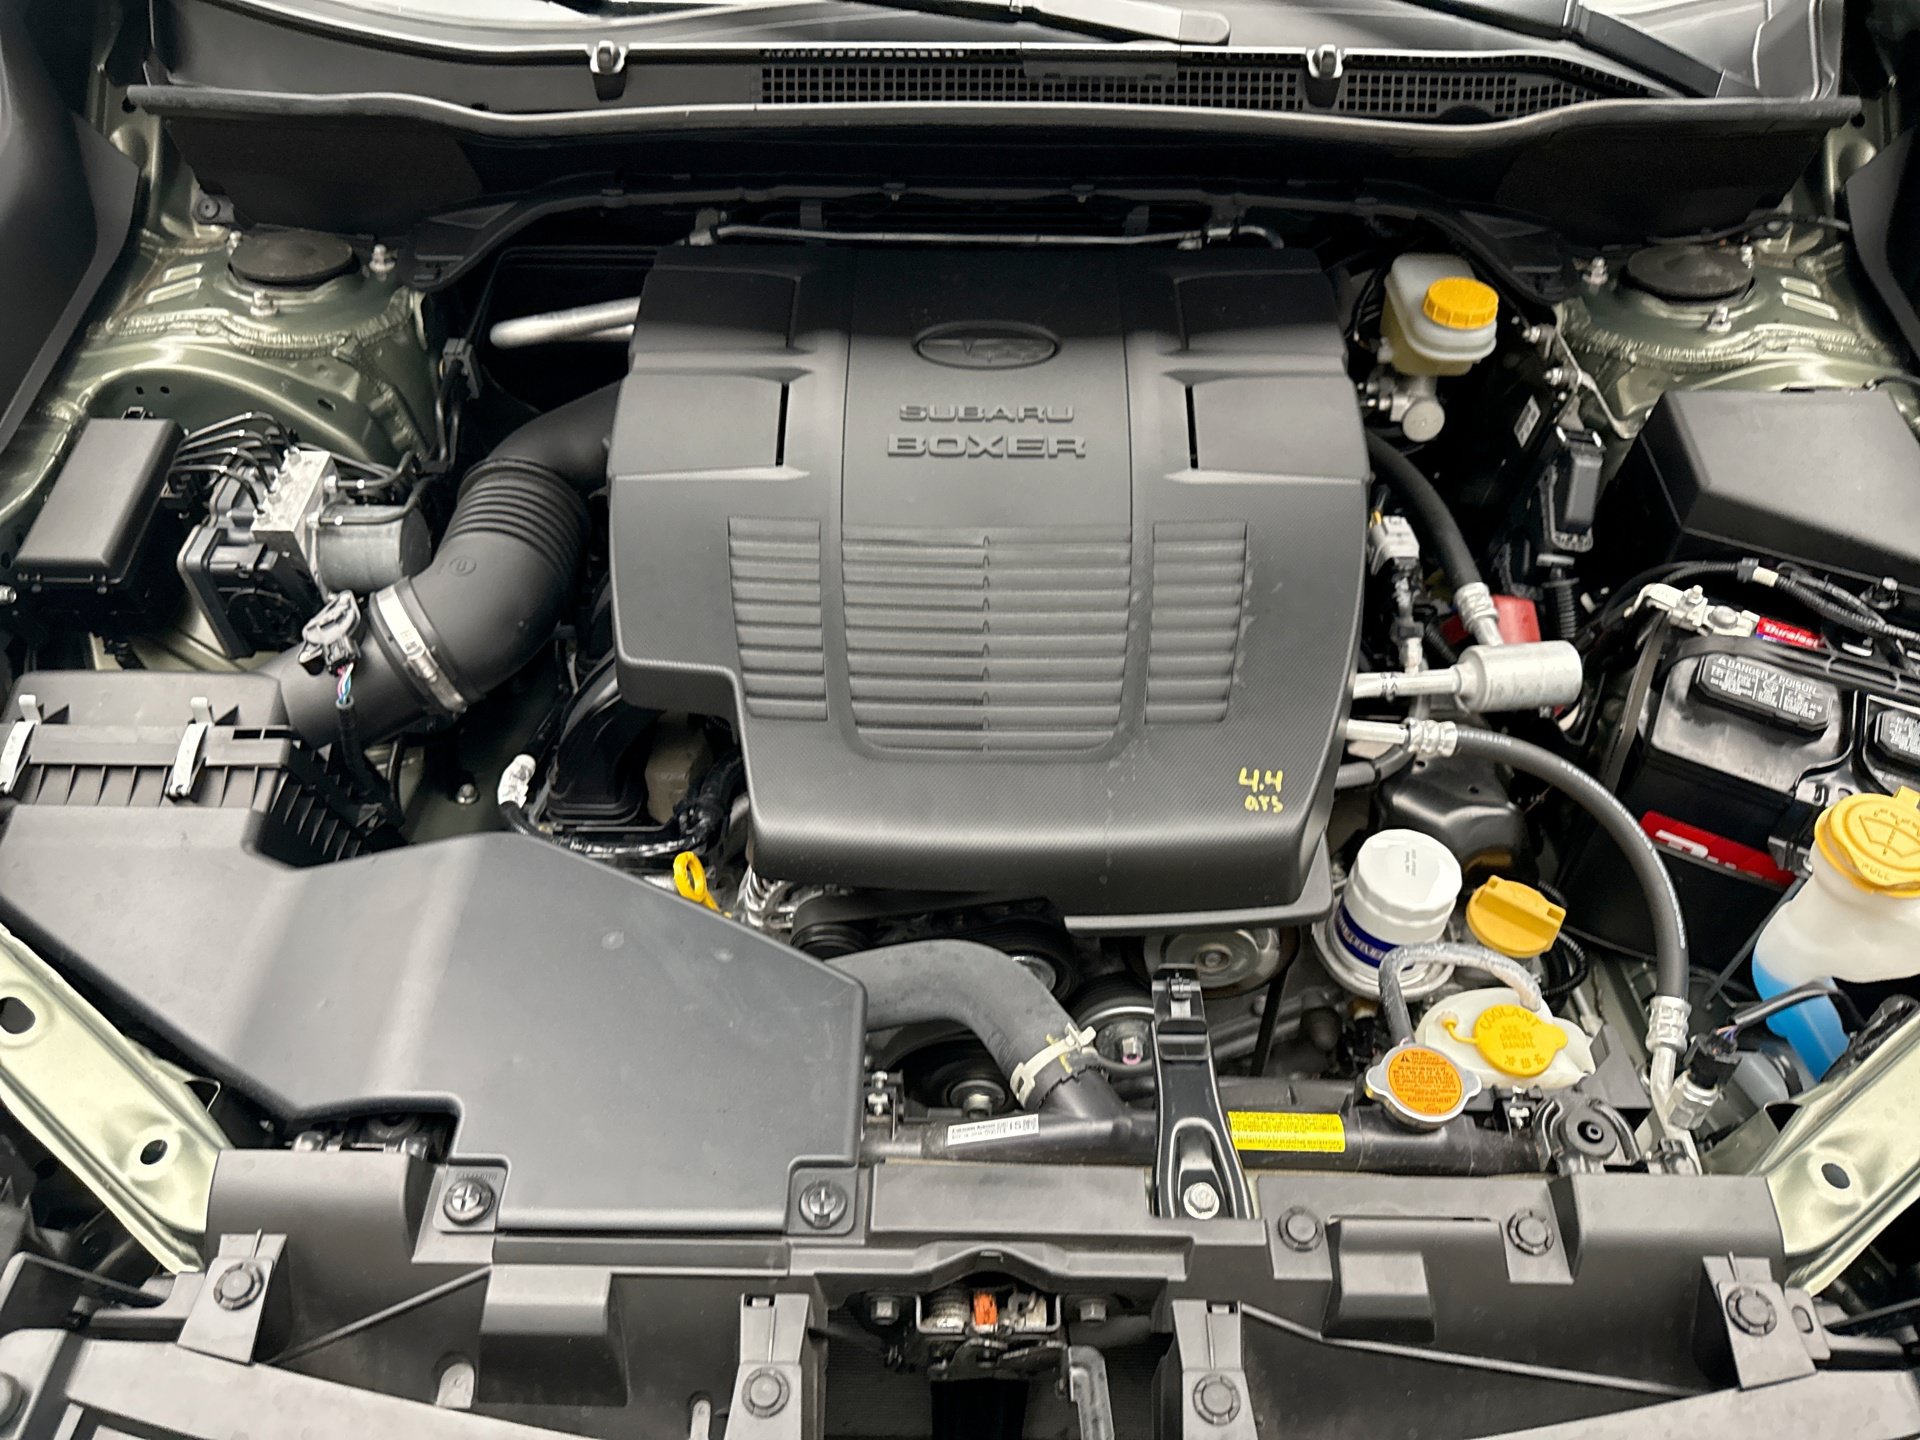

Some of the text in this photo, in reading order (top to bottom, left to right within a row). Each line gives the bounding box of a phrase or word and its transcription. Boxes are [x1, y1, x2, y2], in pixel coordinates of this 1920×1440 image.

[900, 404, 1074, 423] SUBARU
[887, 434, 1086, 458] BOXER
[1763, 622, 1819, 649] Duralast
[1238, 766, 1283, 793] 4.4
[1479, 1006, 1542, 1031] COOLANT
